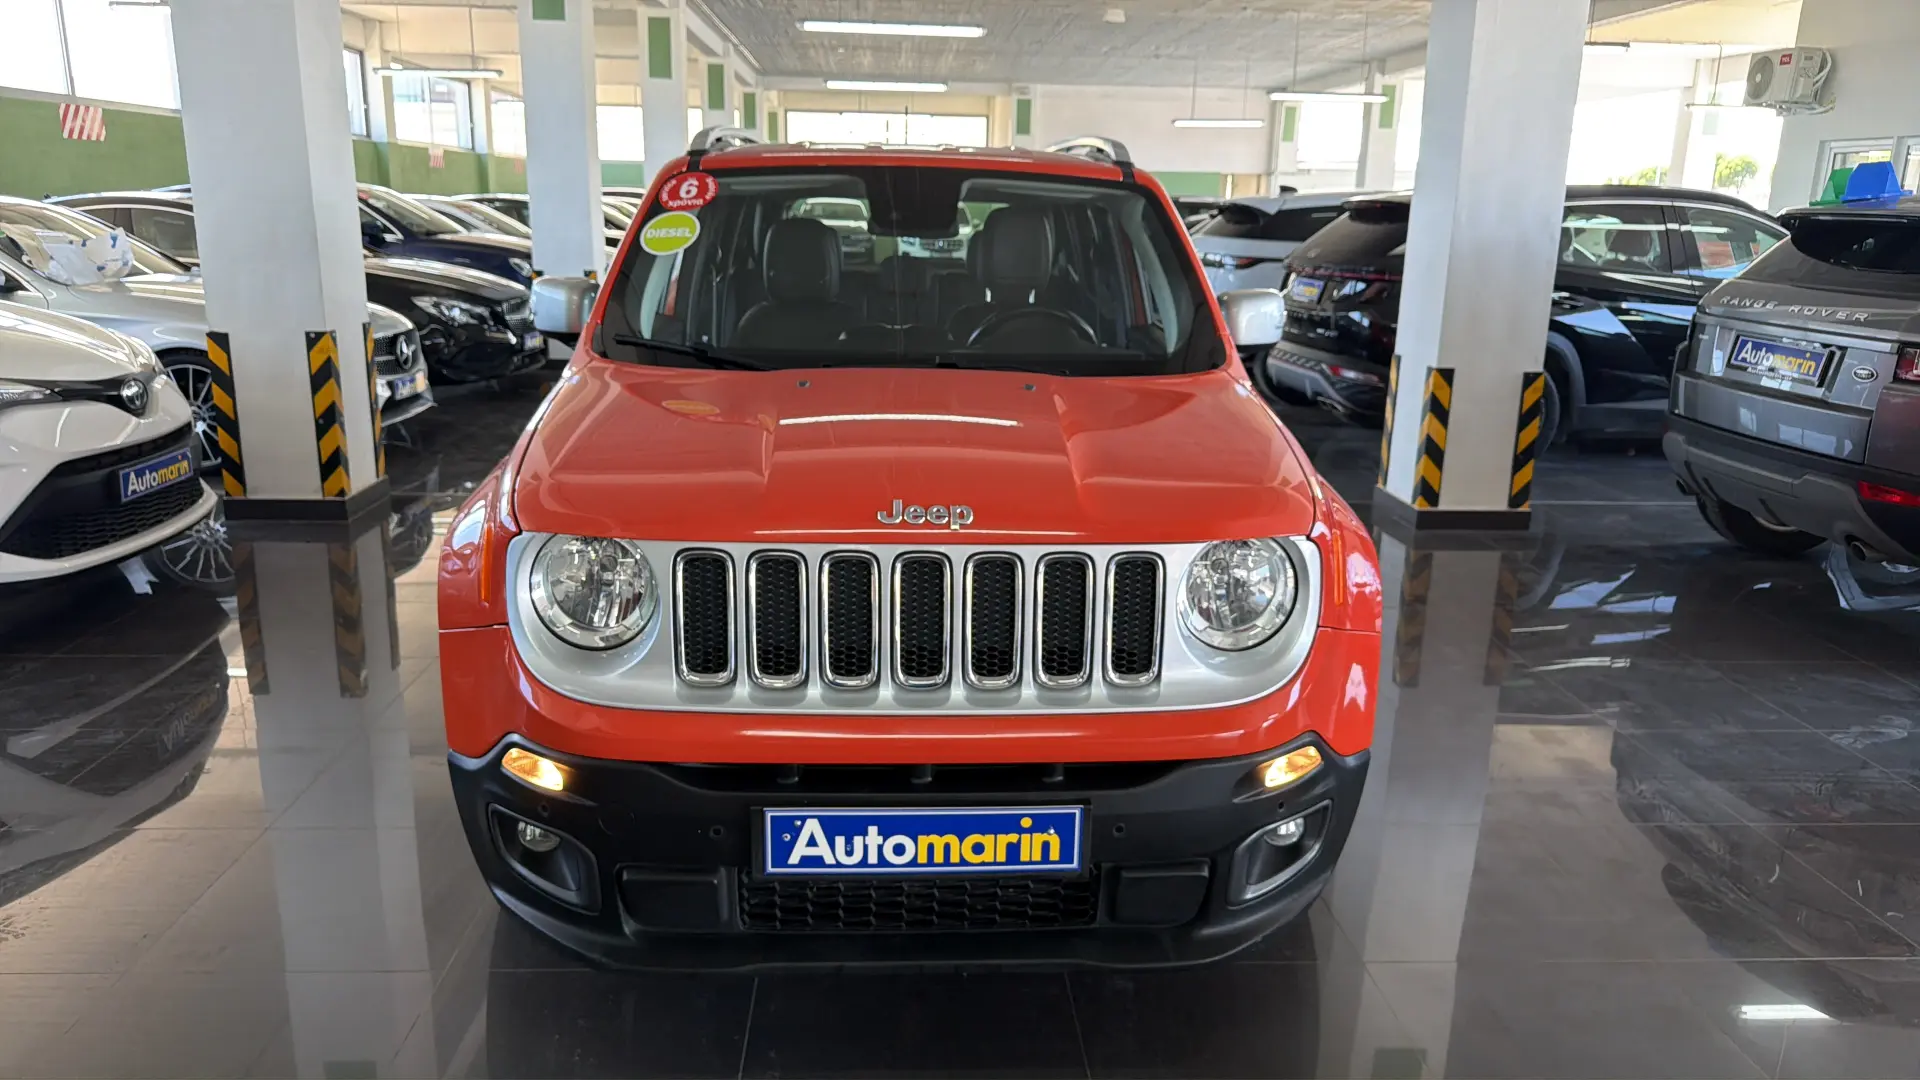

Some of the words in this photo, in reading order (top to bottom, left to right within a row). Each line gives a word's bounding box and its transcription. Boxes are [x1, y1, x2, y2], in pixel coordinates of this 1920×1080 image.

[679, 179, 699, 199] 6
[646, 227, 693, 239] DIESEL
[1720, 296, 1779, 310] RANGE
[1788, 304, 1869, 322] ROVER
[1738, 341, 1816, 375] Automarin
[128, 455, 189, 496] Automarin
[877, 499, 974, 531] Jeep
[787, 816, 1060, 865] Automarin
